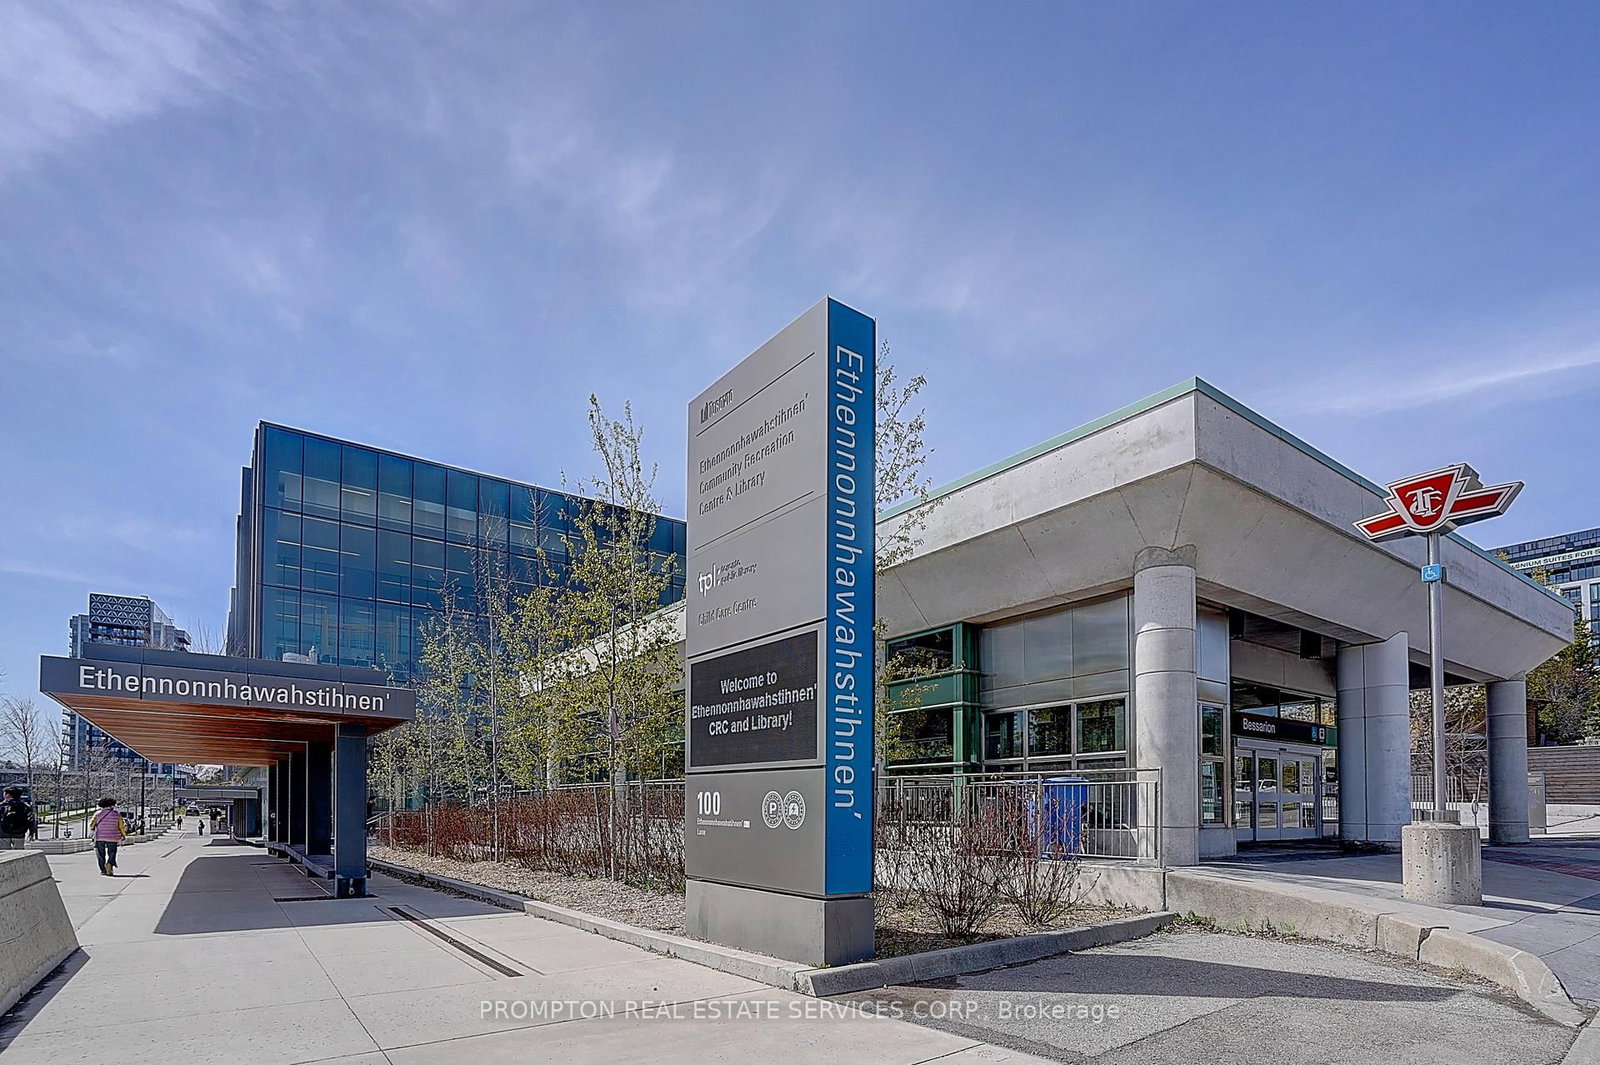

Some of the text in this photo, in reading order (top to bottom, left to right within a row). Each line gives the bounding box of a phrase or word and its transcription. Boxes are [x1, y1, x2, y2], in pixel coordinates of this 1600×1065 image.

[699, 430, 795, 496] Community Recreation
[699, 470, 766, 517] Centre & Library
[1543, 553, 1574, 564] SUITES
[1575, 549, 1593, 558] FOR
[733, 597, 757, 614] Centre
[78, 664, 391, 712] Ethennonnhawahstihnen'
[720, 671, 778, 694] Welcome to
[691, 683, 817, 719] Ethennonnhawahstihnen'
[709, 710, 793, 736] CRC and Library!
[1242, 717, 1276, 734] Bessarion
[697, 791, 721, 816] 100
